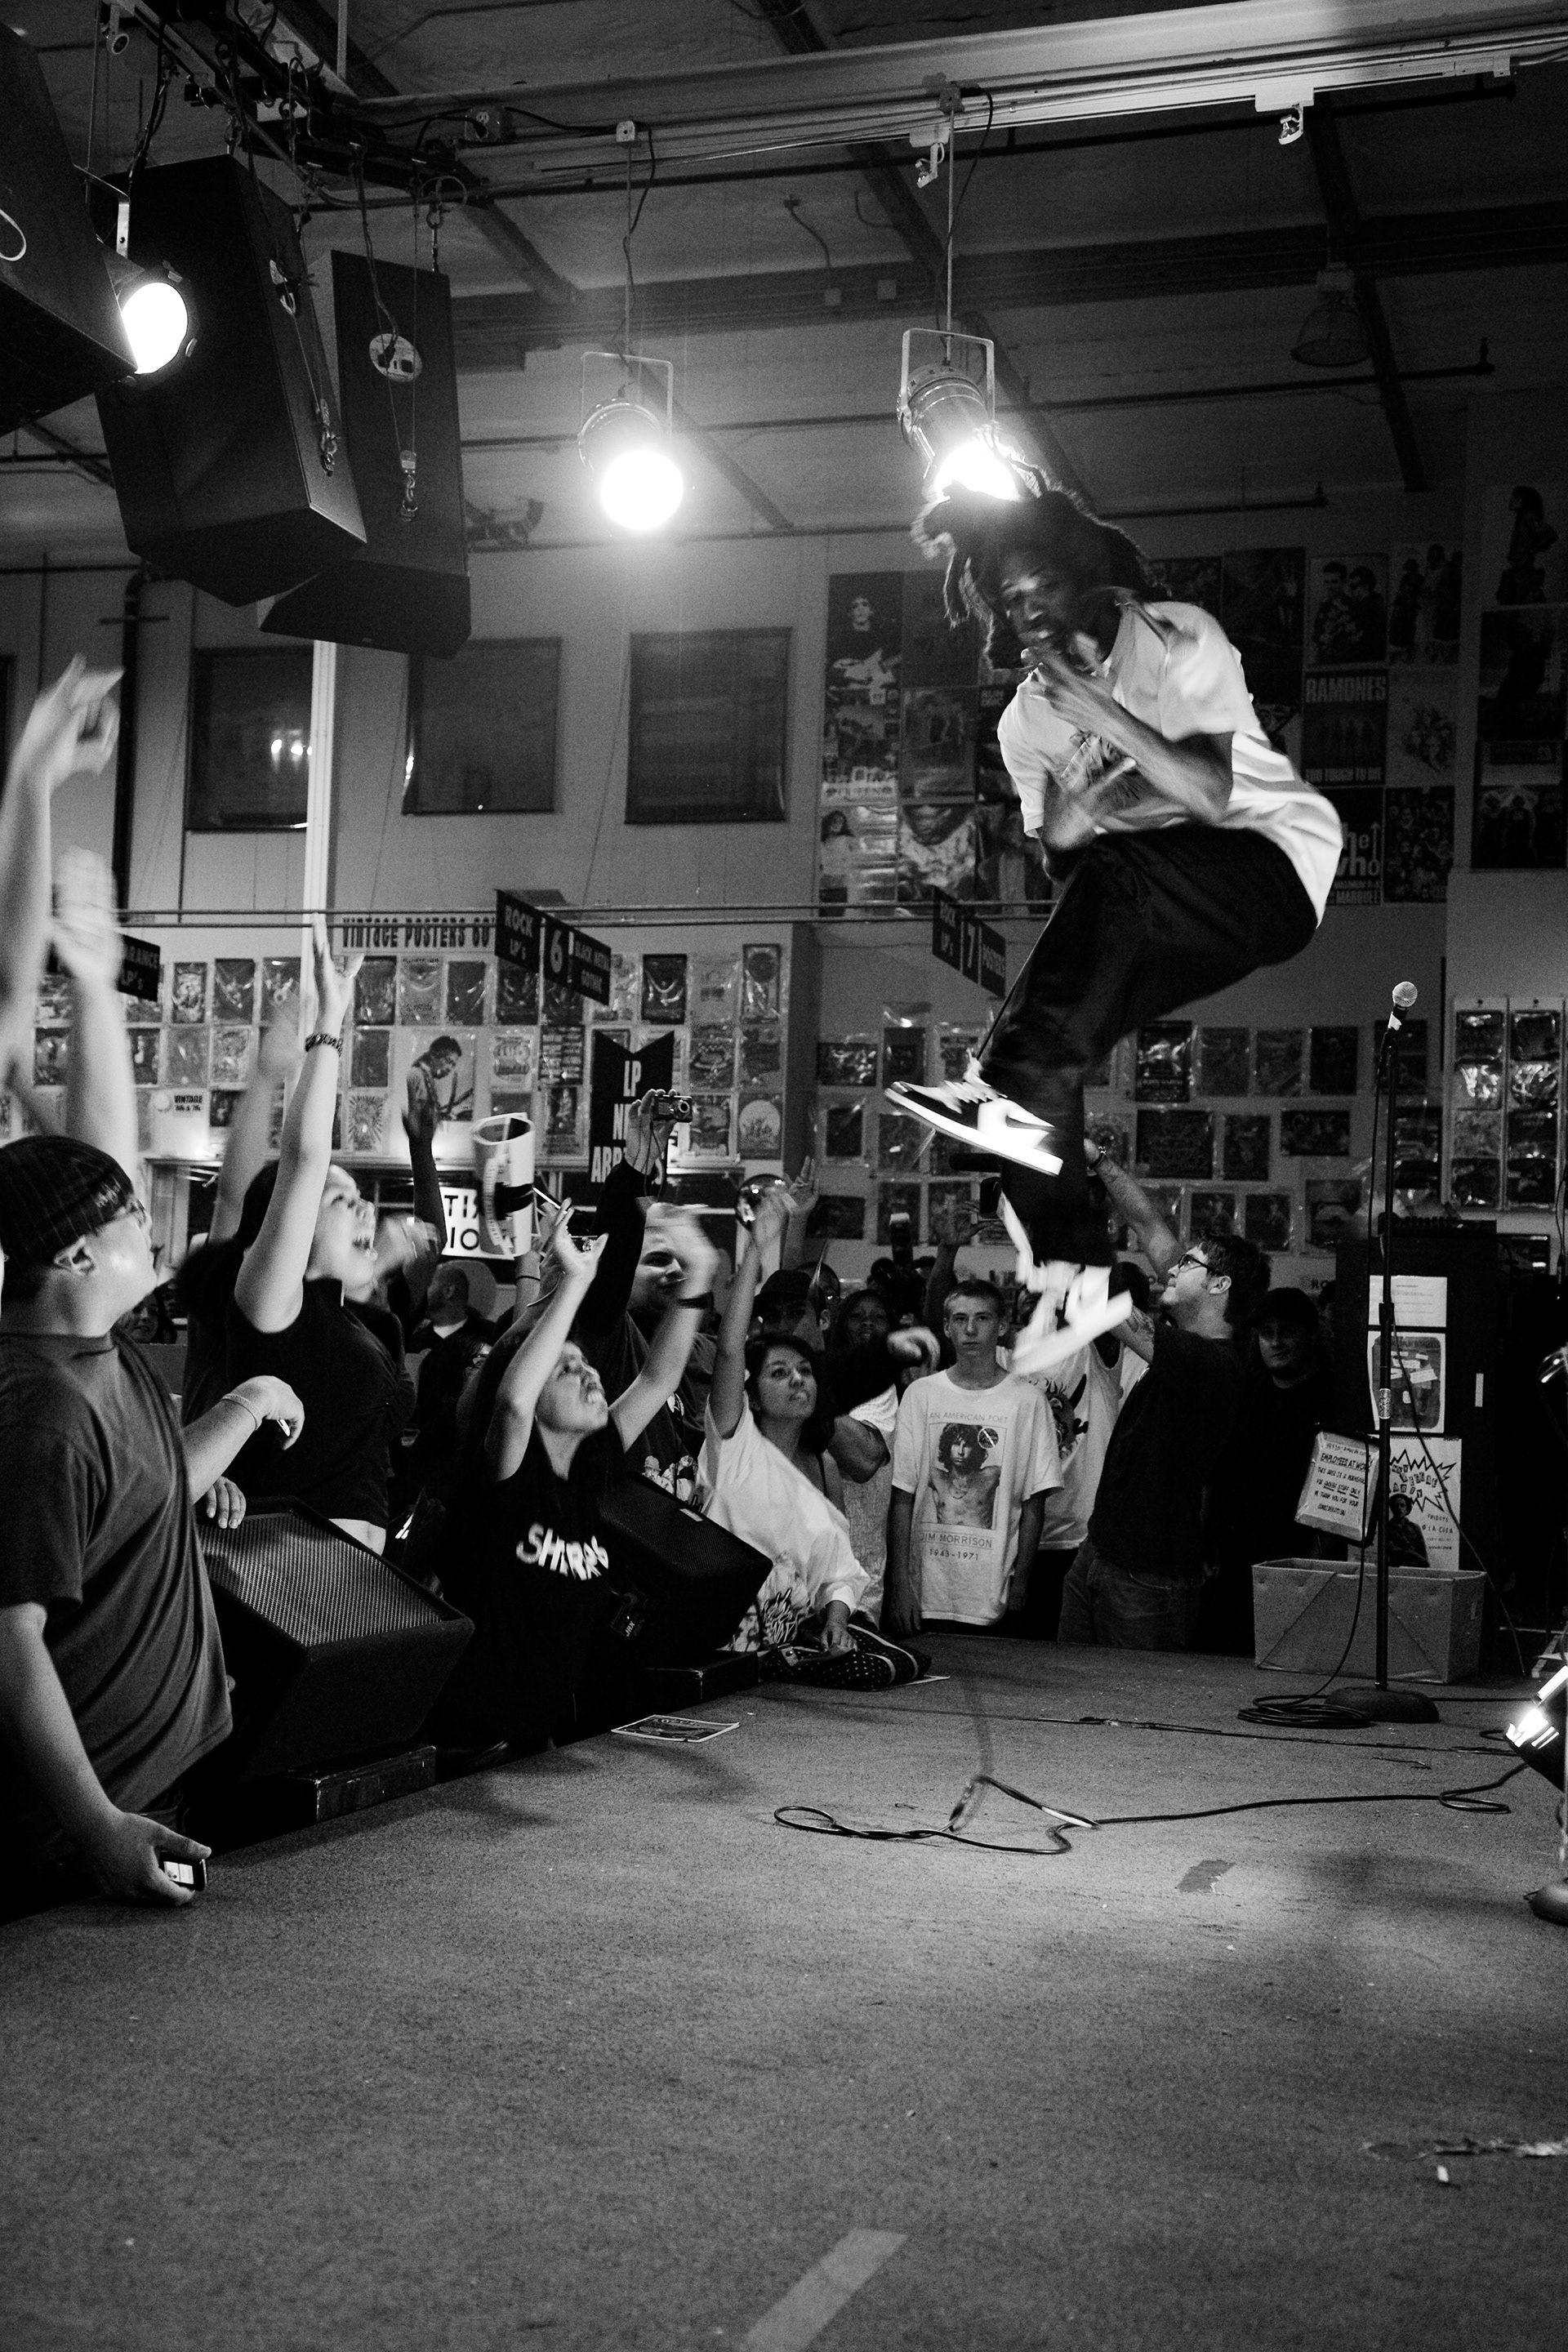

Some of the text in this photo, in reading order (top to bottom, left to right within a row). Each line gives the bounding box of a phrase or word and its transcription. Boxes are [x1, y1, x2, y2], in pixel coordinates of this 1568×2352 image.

[1307, 676, 1386, 702] RAMONES
[1342, 822, 1370, 849] he
[343, 918, 398, 947] VINTAGE
[405, 918, 466, 947] POSTERS
[505, 905, 533, 938] ROCK
[550, 929, 563, 973] 6
[623, 1061, 642, 1097] LP
[612, 1103, 633, 1140] NE
[943, 1412, 986, 1421] AMERICAN
[989, 1414, 1008, 1423] POET
[1321, 1453, 1349, 1467] EMPLOYEES
[1348, 1460, 1356, 1468] AT
[1392, 1482, 1423, 1498] ARTY
[921, 1532, 992, 1548] JIM MORRISON
